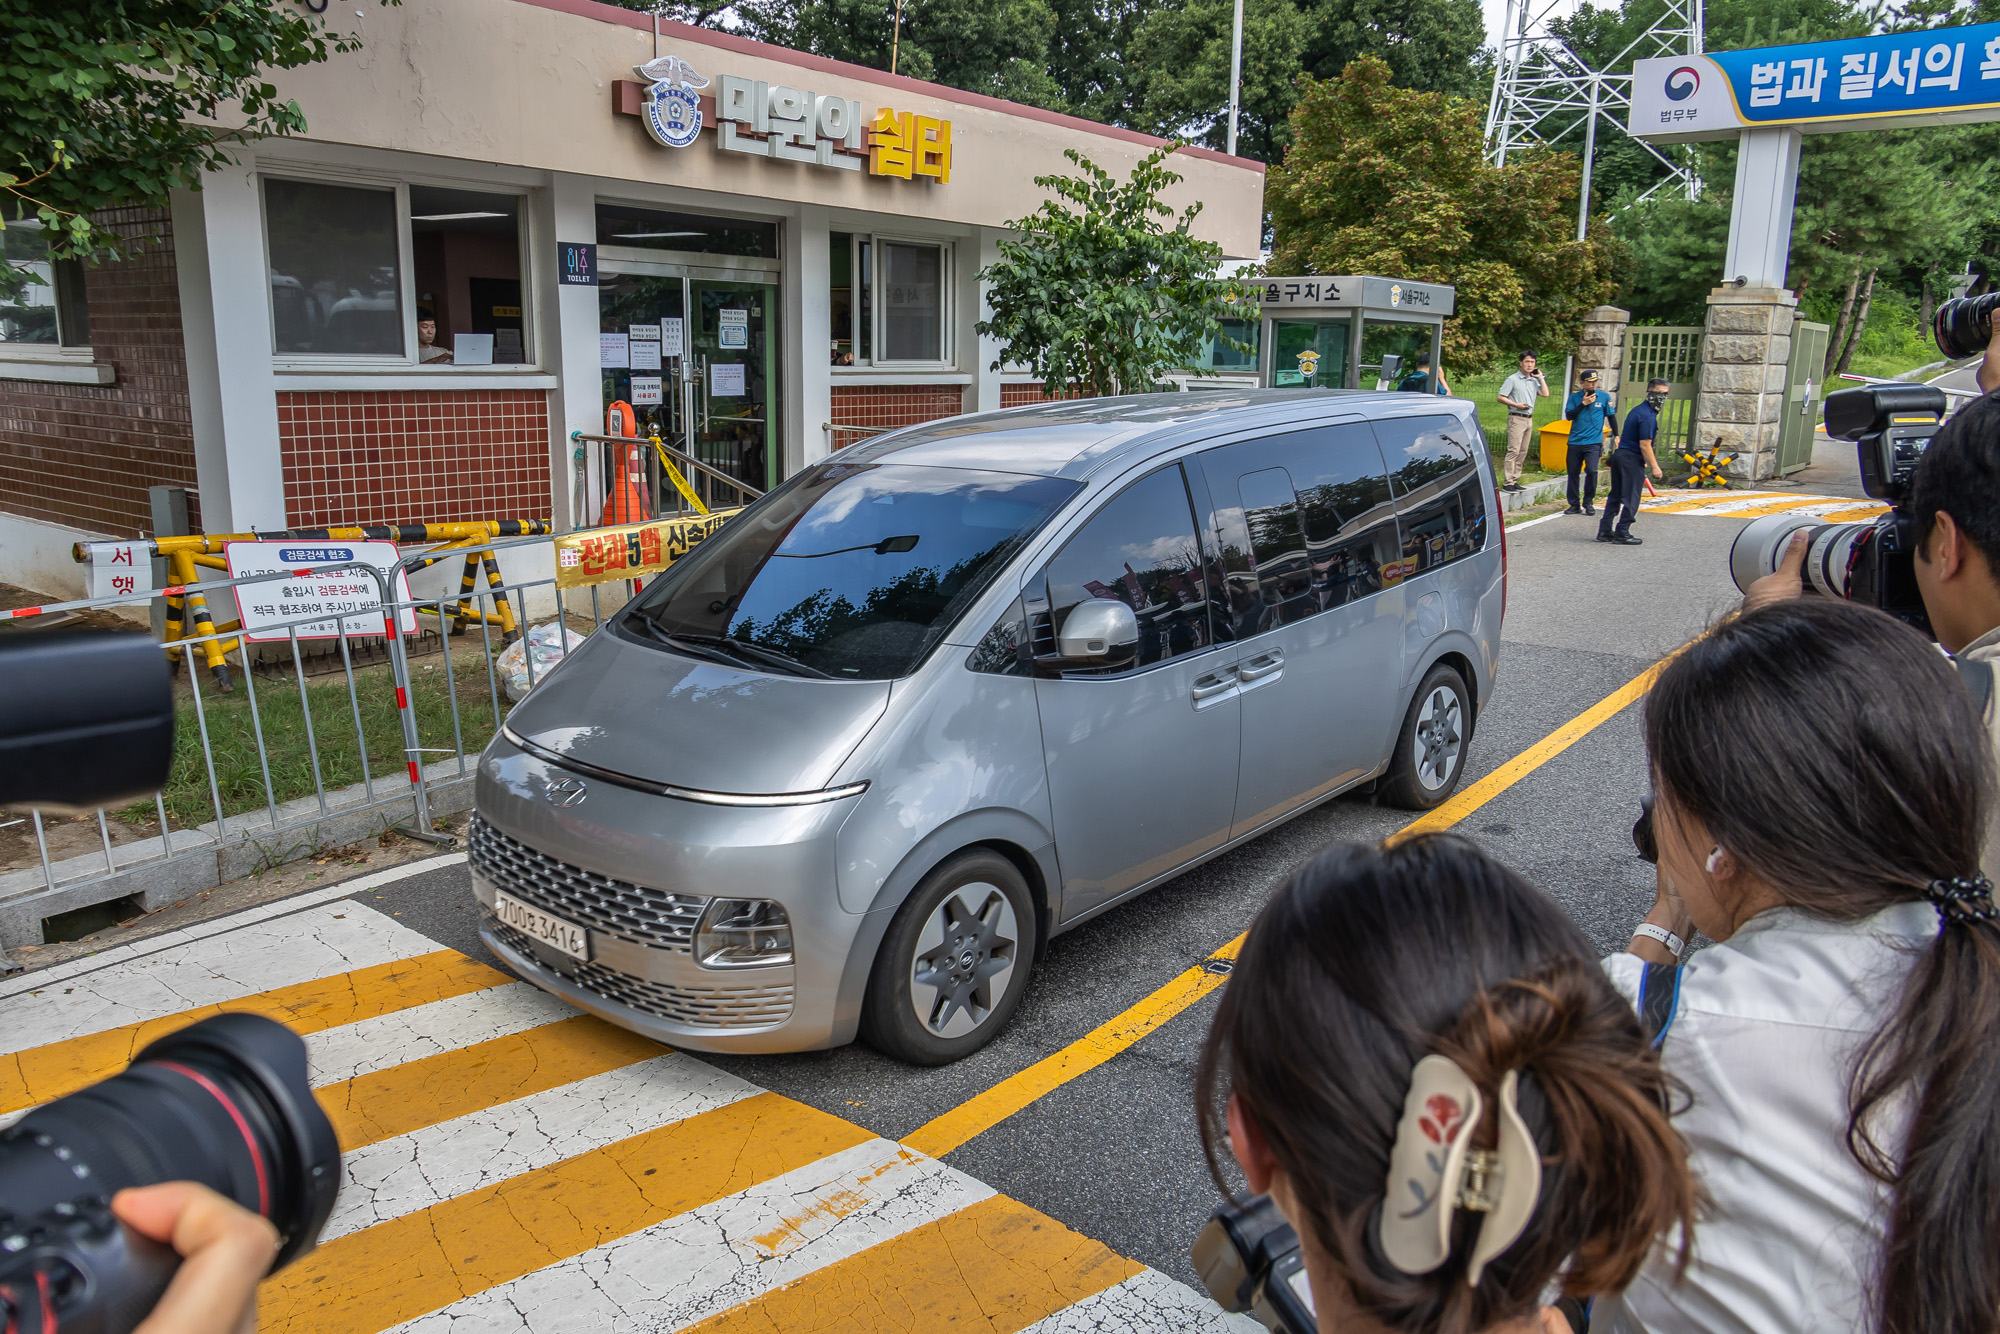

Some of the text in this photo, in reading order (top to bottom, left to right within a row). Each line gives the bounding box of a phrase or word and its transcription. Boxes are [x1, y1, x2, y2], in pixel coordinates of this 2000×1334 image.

[1749, 57, 1828, 107] 법과
[1839, 42, 1966, 100] 질서의
[1660, 108, 1698, 123] 법무부
[716, 74, 952, 184] 민원인 쉼터
[566, 274, 591, 283] TOILET
[1401, 288, 1431, 307] 서울구치소
[286, 549, 348, 561] 검문검색 협조
[580, 527, 661, 576] 전과5범
[111, 546, 134, 595] 서행
[281, 583, 370, 598] 출입시 검문검색에
[252, 604, 275, 617] 적극
[279, 603, 323, 616] 협조하여
[325, 601, 357, 614] 주시기
[539, 916, 581, 954] 3416
